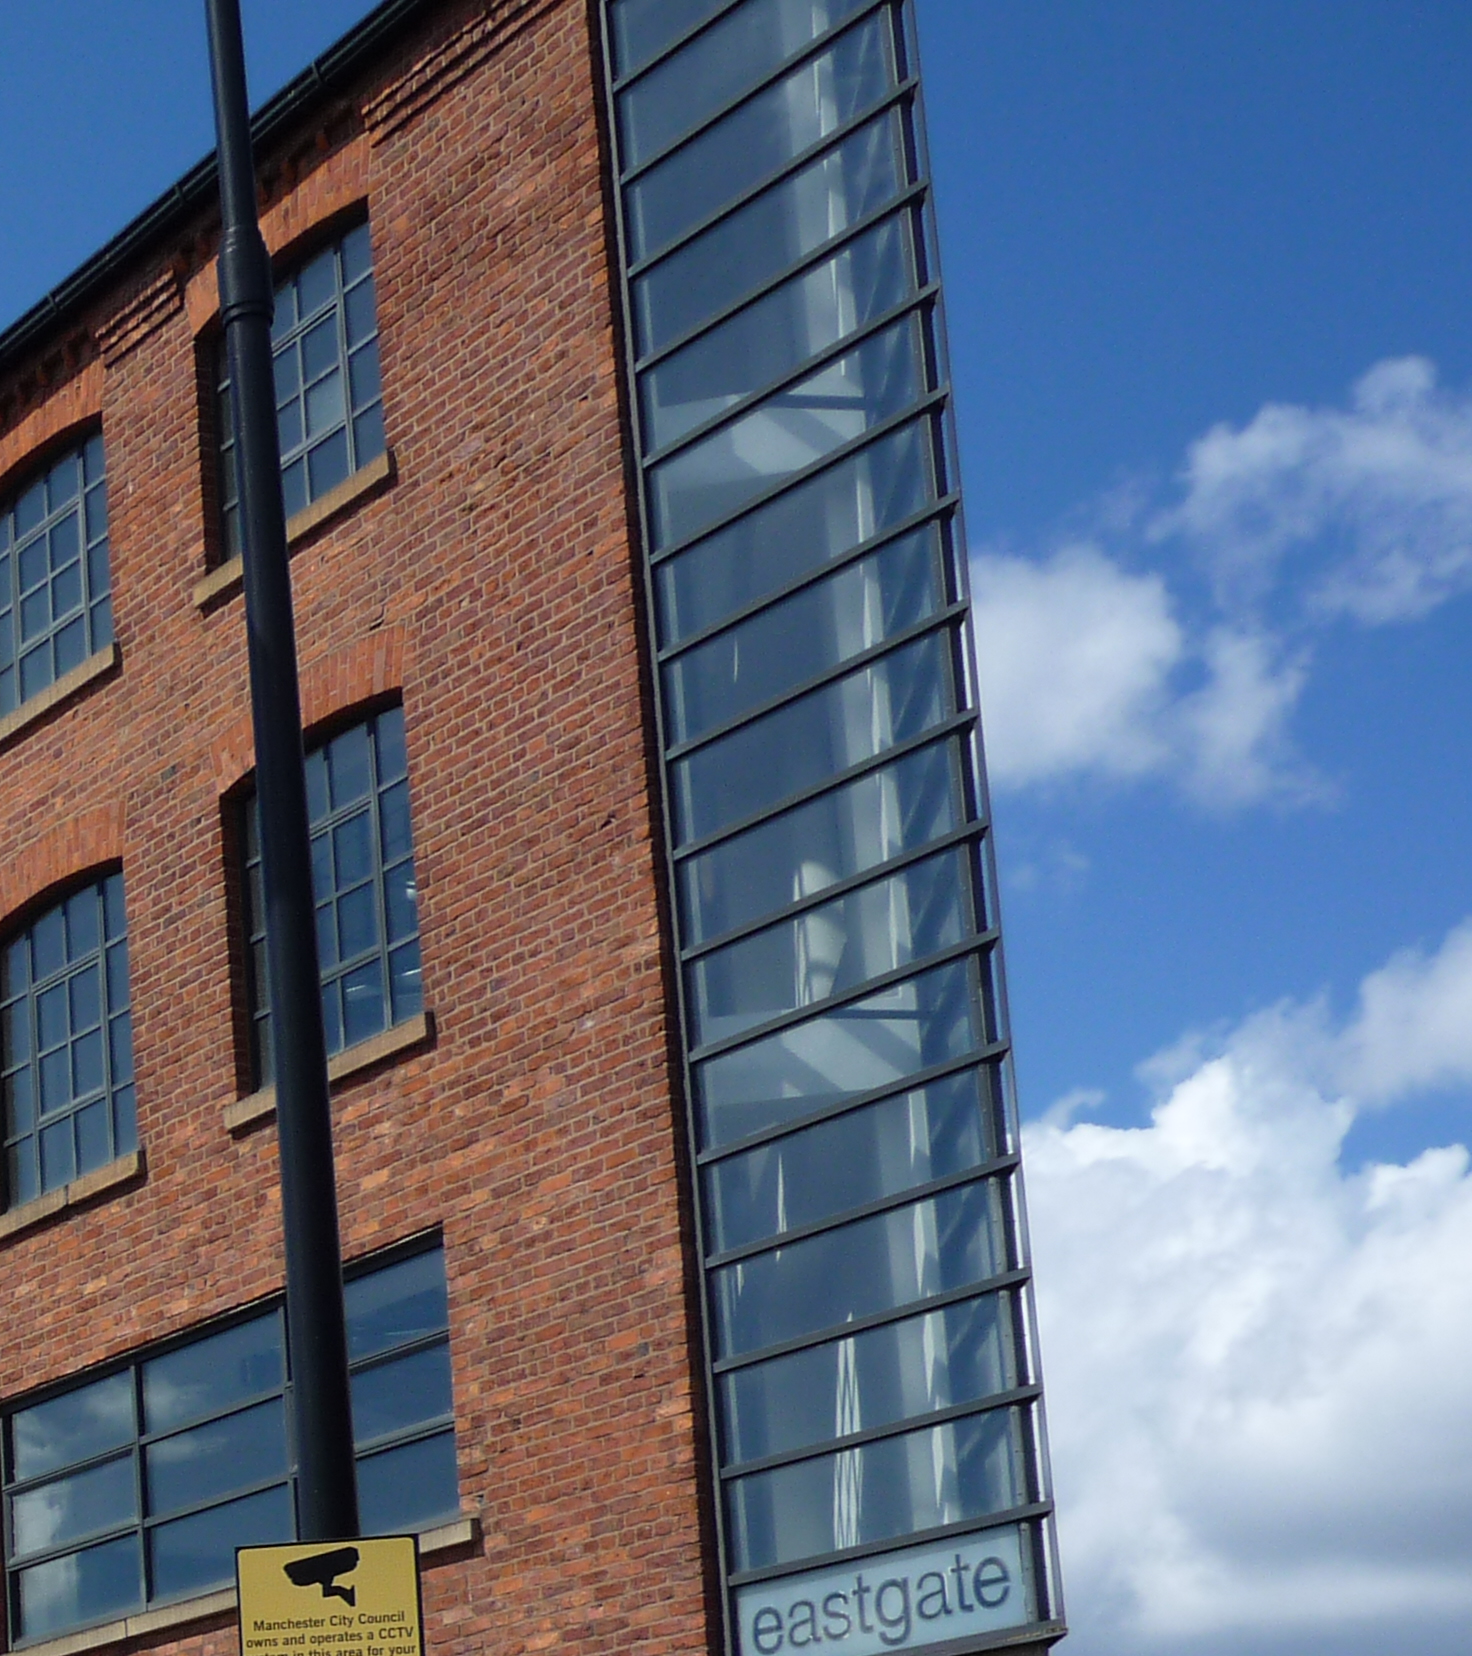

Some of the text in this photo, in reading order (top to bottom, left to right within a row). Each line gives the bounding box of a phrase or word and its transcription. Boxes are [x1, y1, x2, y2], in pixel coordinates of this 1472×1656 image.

[752, 1554, 1011, 1655] eastgate
[253, 1610, 405, 1632] Manchester City Council
[246, 1626, 414, 1648] owns and operates a CCTV
[367, 1645, 384, 1656] for
